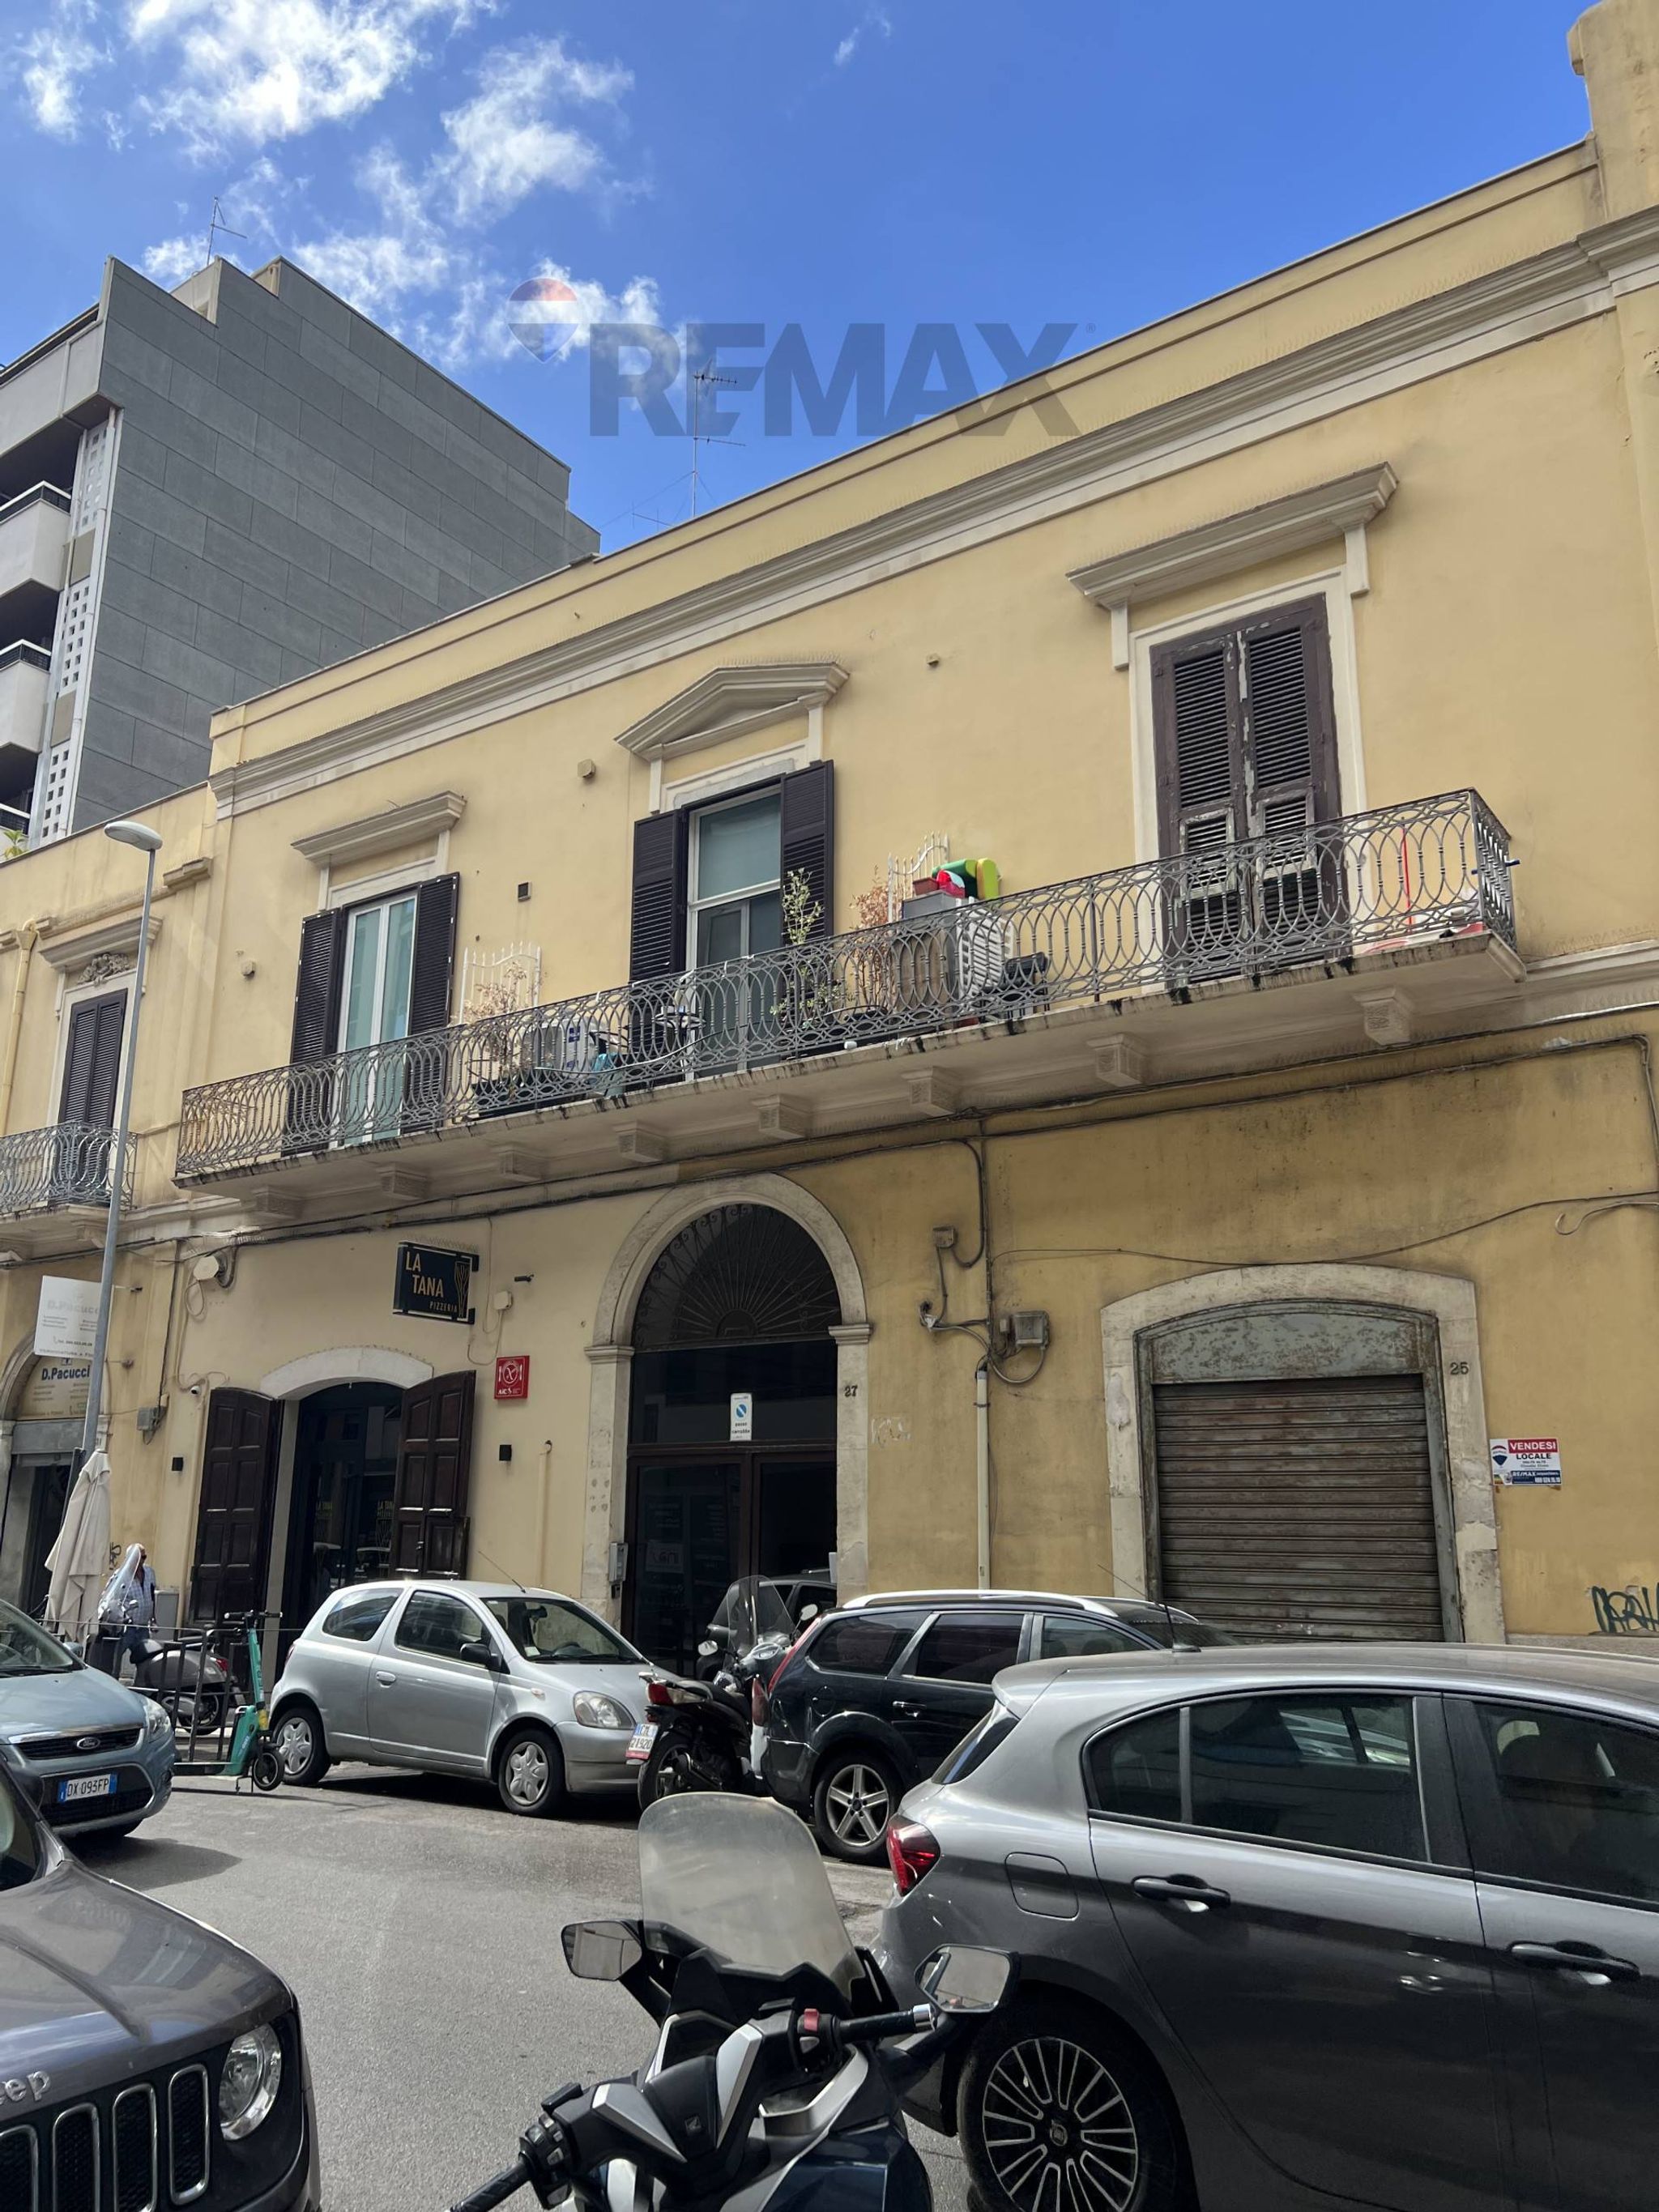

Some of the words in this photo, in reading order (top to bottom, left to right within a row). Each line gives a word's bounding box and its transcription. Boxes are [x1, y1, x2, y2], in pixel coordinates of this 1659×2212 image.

[406, 1251, 421, 1272] LA
[412, 1274, 444, 1298] TANA
[429, 1301, 458, 1313] PIZZERIA
[41, 1365, 91, 1381] D.Pacucci
[1450, 1362, 1469, 1375] 25
[844, 1385, 858, 1397] 27
[1509, 1442, 1556, 1450] VENDESI
[67, 1783, 79, 1797] DX
[81, 1778, 109, 1794] 093FP
